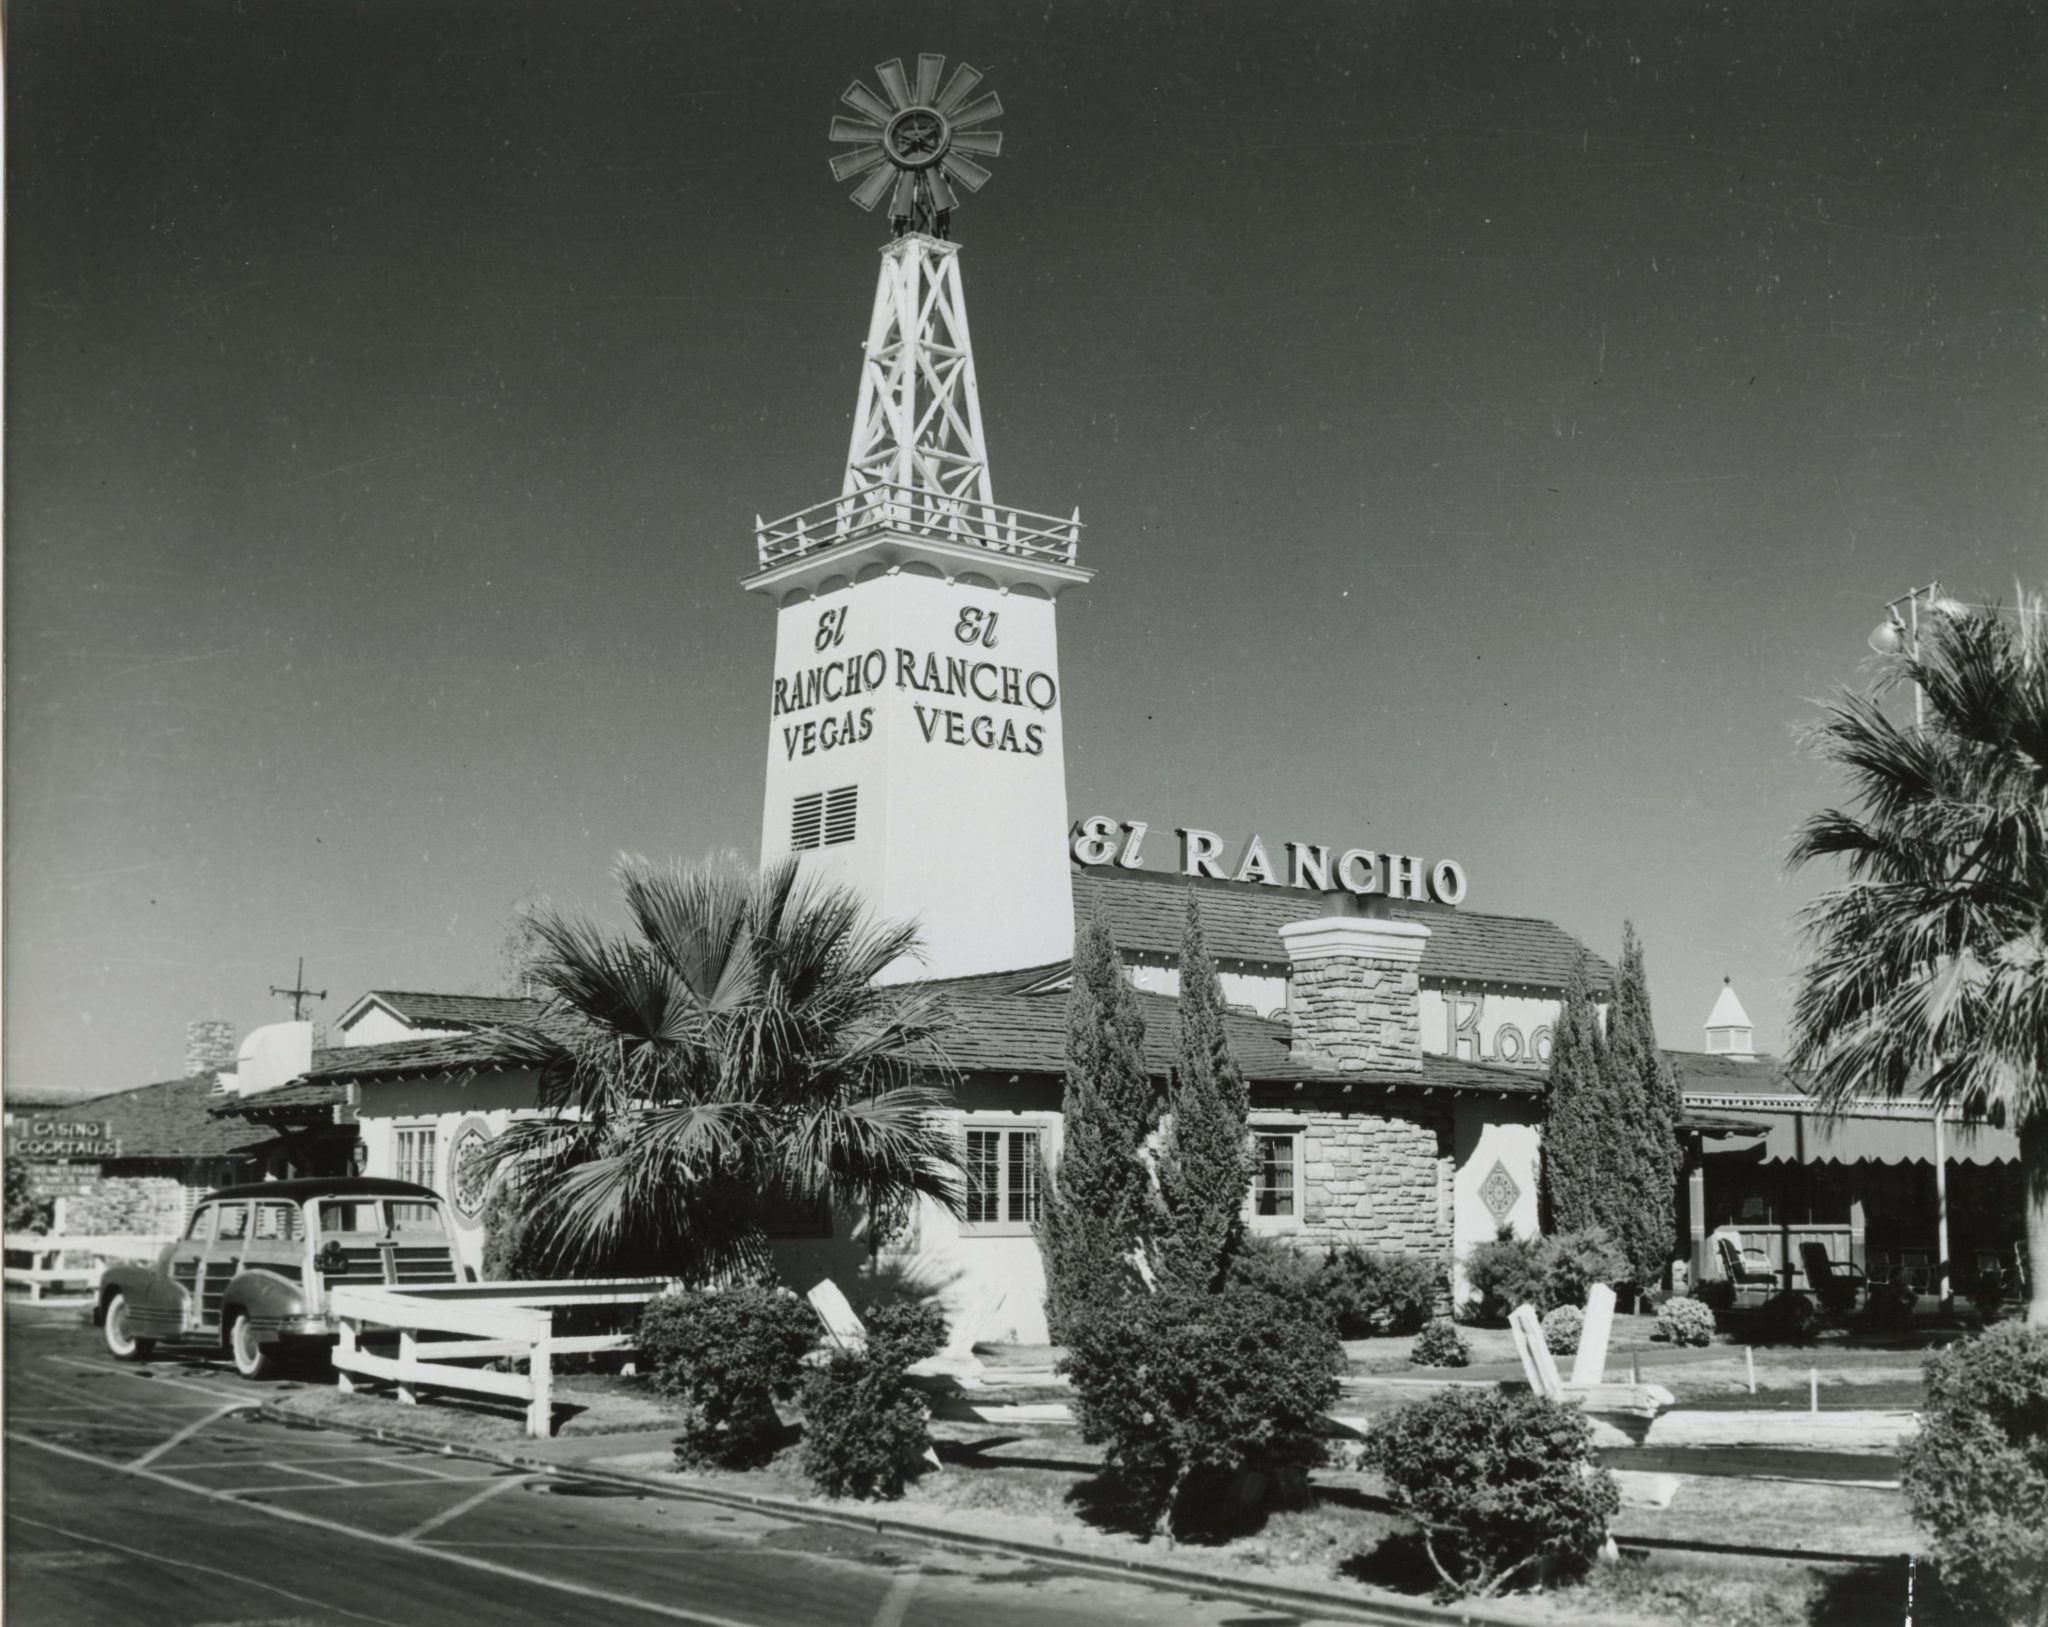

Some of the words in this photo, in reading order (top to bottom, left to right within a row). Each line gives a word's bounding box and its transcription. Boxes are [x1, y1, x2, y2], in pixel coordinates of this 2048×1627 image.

[815, 605, 848, 653] El
[954, 605, 999, 648] El
[773, 649, 887, 716] RANCHO
[895, 648, 1057, 712] RANCHO
[783, 706, 875, 761] VEGAS
[913, 702, 1046, 756] VEGAS
[1070, 815, 1149, 869] El
[1175, 827, 1468, 905] RANCHO
[1441, 989, 1552, 1072] Roo
[16, 1140, 115, 1156] COCKTAILS
[33, 1122, 100, 1137] CASINO
